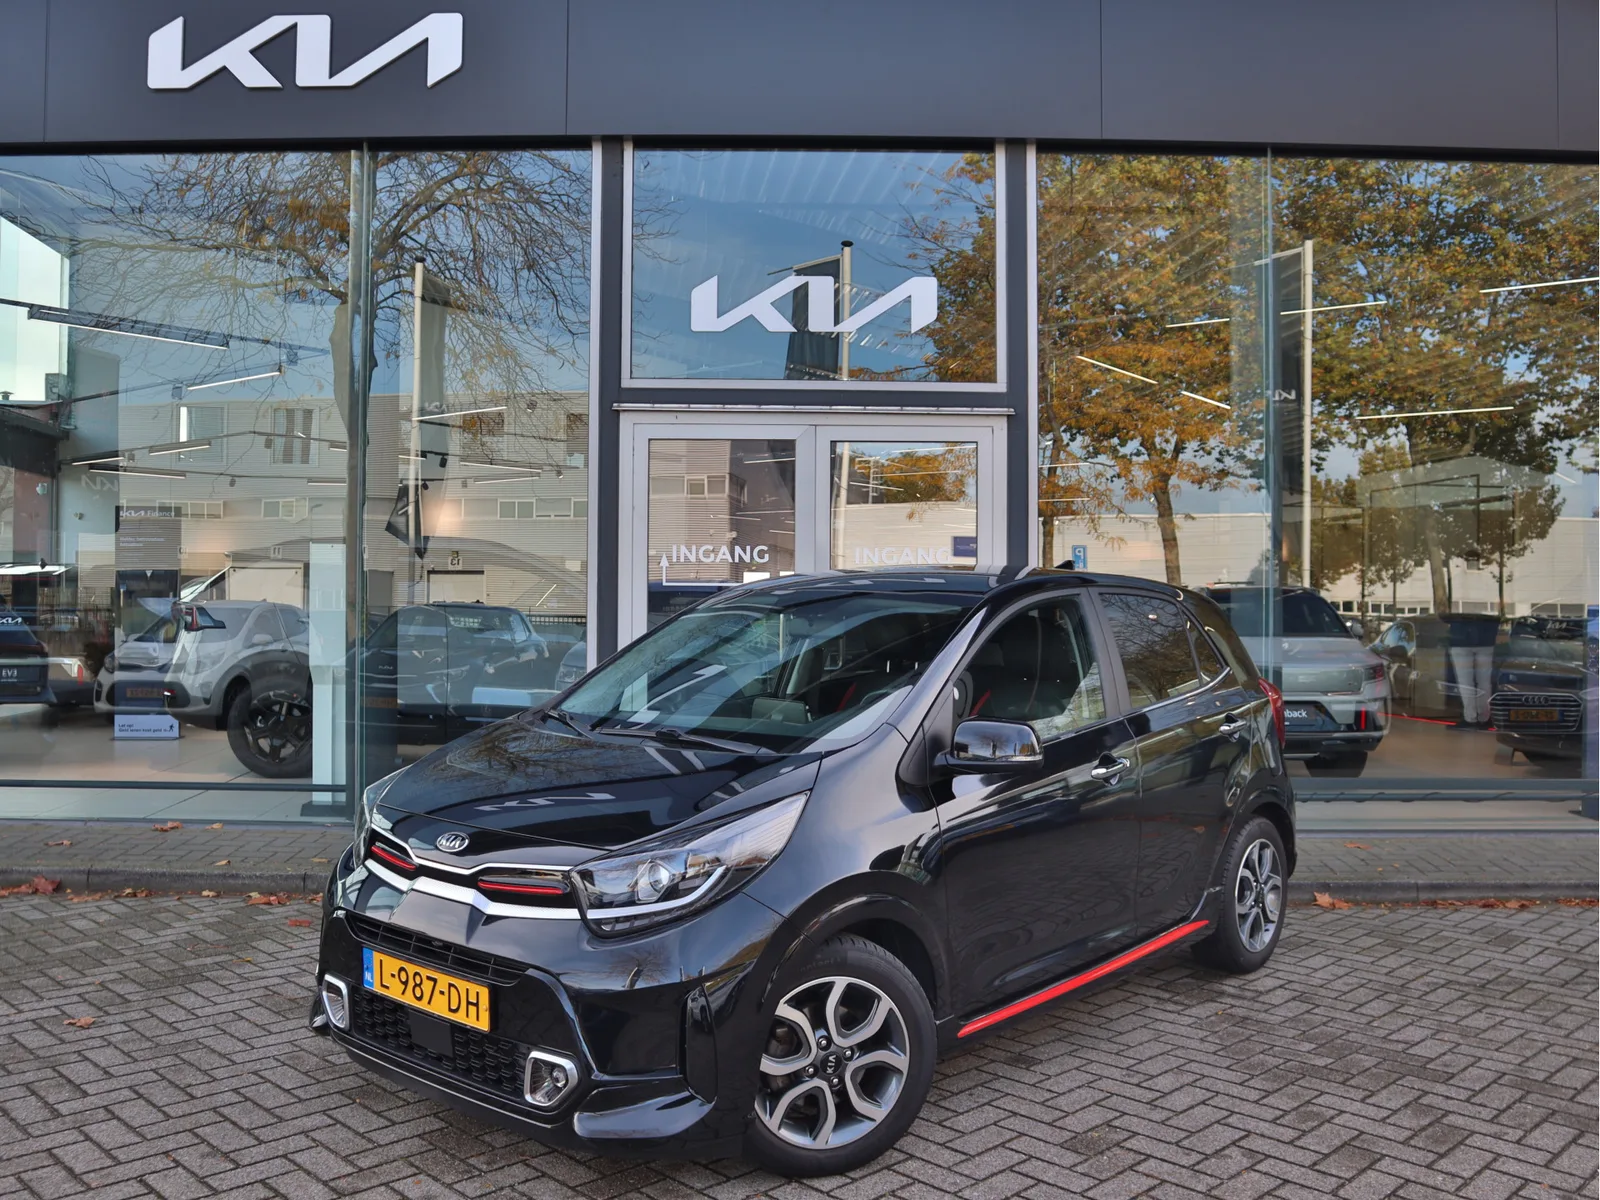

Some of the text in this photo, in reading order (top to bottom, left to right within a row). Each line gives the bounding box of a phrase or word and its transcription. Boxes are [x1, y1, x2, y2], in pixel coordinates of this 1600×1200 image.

[147, 12, 464, 90] KIA
[690, 275, 938, 334] KIA
[147, 509, 175, 517] Finance
[672, 544, 769, 563] INGANG
[855, 547, 951, 565] INGANG
[440, 834, 463, 849] KIA
[365, 970, 374, 982] NL
[379, 958, 480, 1022] L-987-DH
[826, 1054, 837, 1074] KIA
